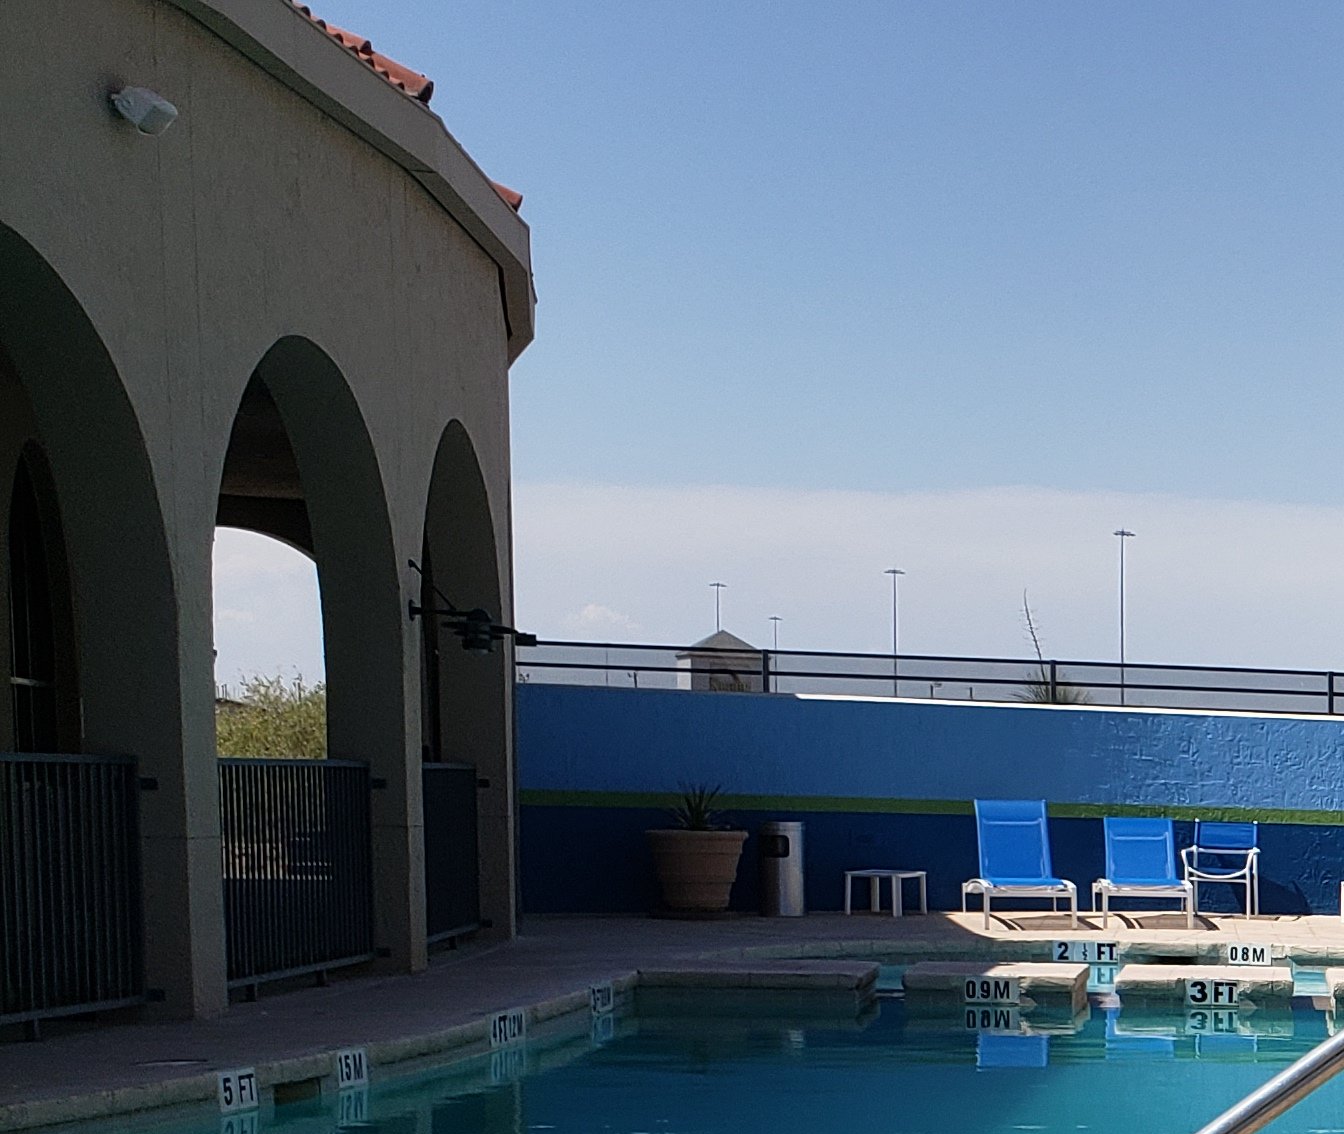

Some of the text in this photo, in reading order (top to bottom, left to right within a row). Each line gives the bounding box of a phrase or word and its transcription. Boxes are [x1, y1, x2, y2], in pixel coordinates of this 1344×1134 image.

[1057, 942, 1069, 960] 2
[1189, 981, 1208, 1003] 3
[222, 1073, 254, 1106] 5 FT
